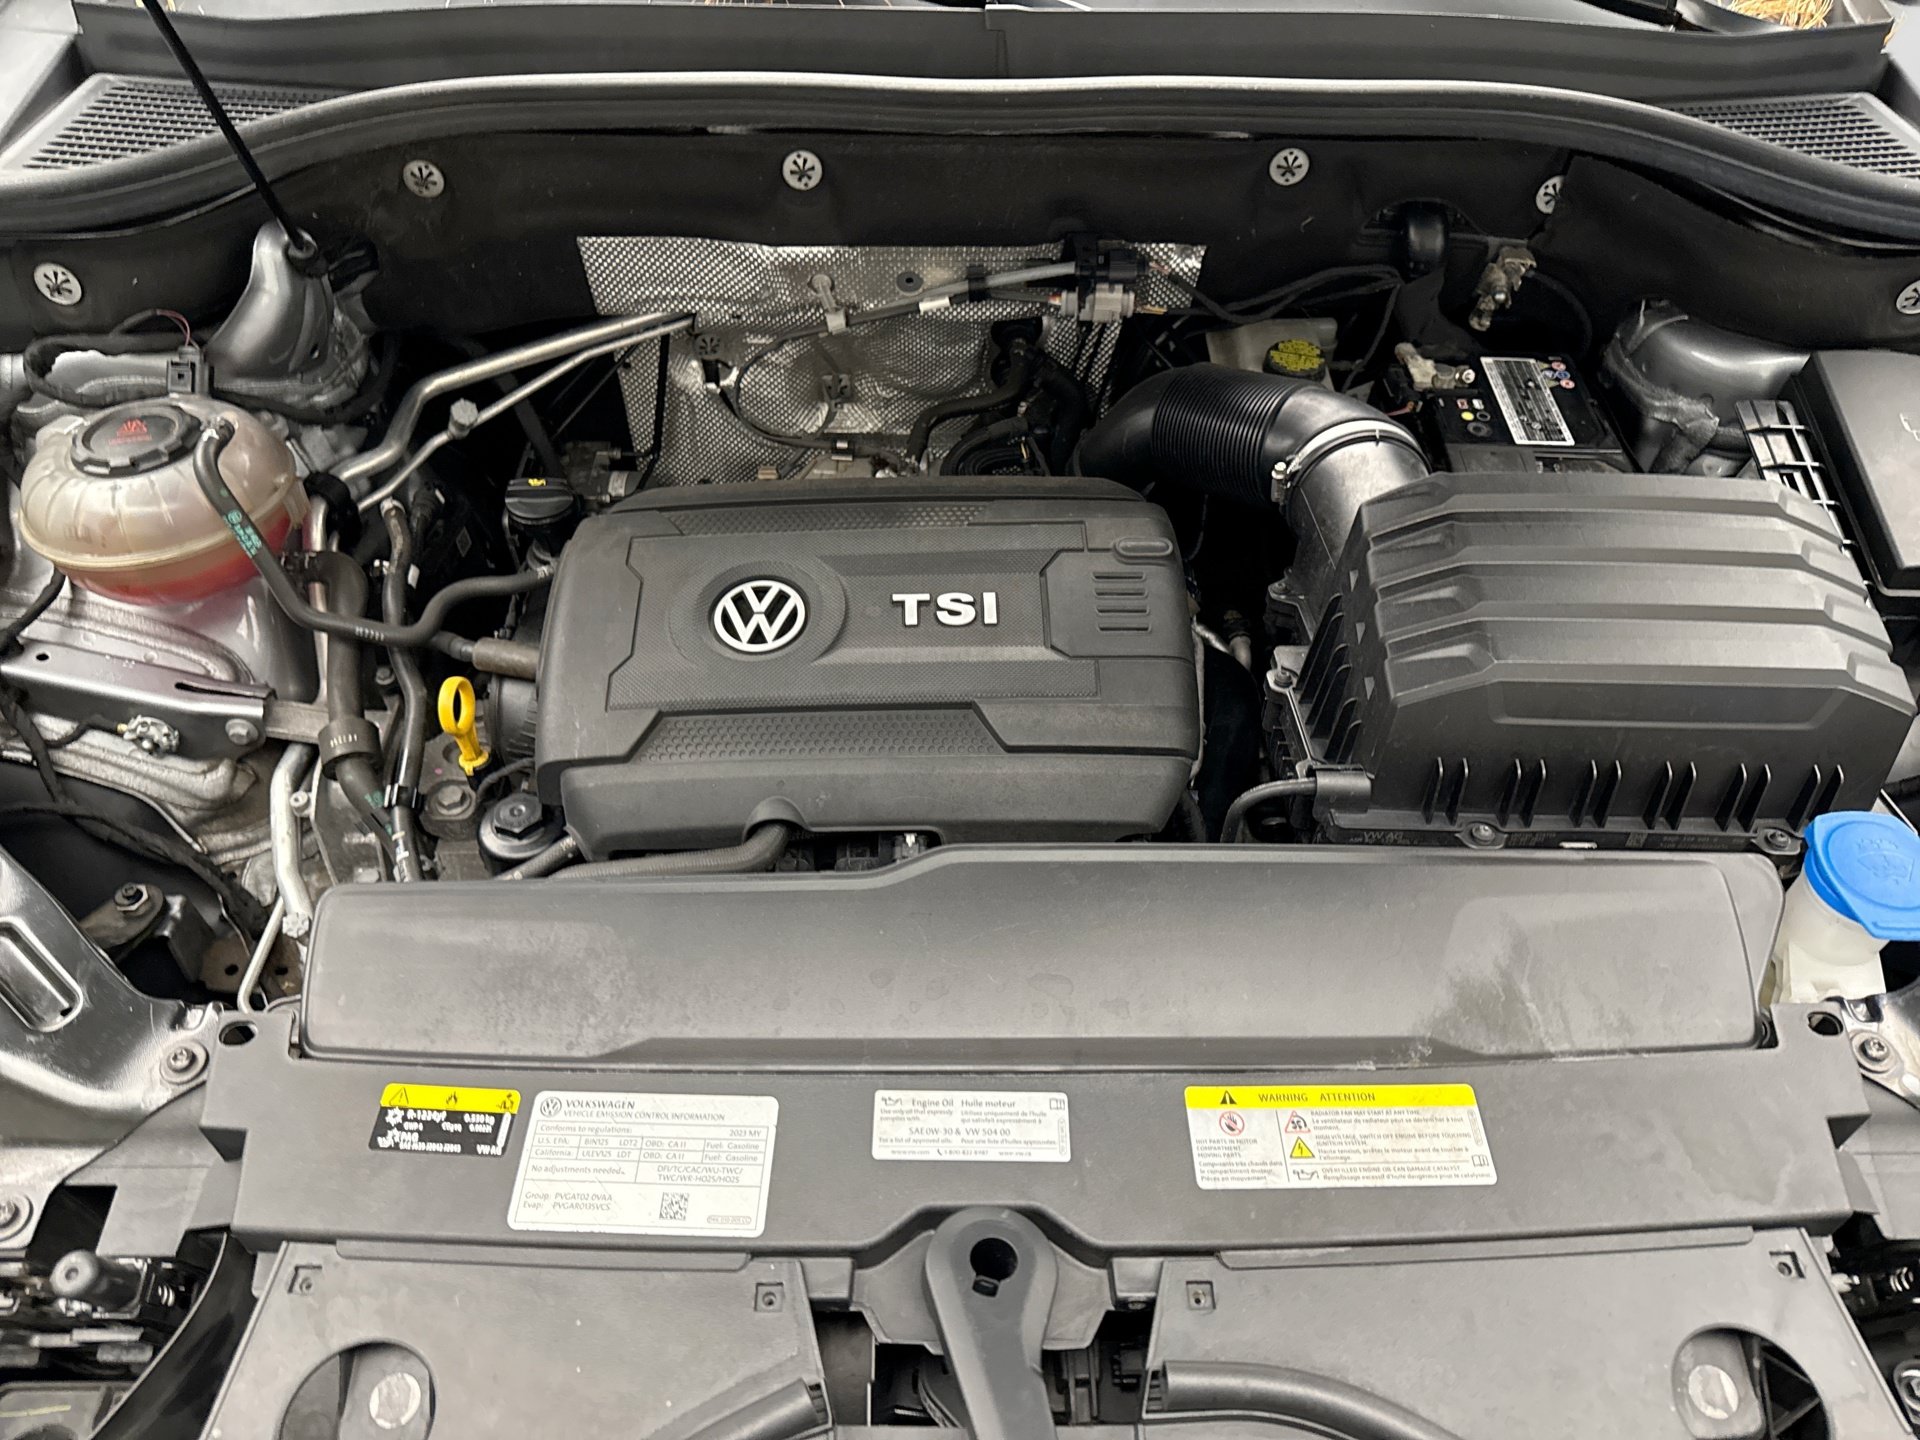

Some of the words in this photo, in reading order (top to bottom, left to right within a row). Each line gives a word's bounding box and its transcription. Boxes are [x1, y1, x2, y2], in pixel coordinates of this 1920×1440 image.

[892, 591, 998, 626] TSI
[1257, 1092, 1308, 1102] WARNING
[1319, 1092, 1376, 1102] ATTENTION
[566, 1099, 635, 1110] VOLKSWAGEN
[912, 1098, 940, 1110] Engine
[941, 1098, 954, 1107] Oil
[961, 1099, 983, 1107] Huile
[985, 1100, 1016, 1108] moteur
[564, 1110, 593, 1118] VEHICLE
[596, 1110, 633, 1119] EMISSION
[635, 1112, 669, 1120] CONTROL
[671, 1112, 725, 1121] INFORMATION
[540, 1124, 576, 1133] Conforms
[587, 1127, 632, 1136] regulations:
[729, 1129, 747, 1137] 2023
[748, 1129, 762, 1137] MY
[908, 1127, 925, 1136] SAE
[954, 1127, 961, 1136] &
[965, 1128, 980, 1136] VW
[981, 1128, 998, 1137] 504
[999, 1128, 1011, 1137] 00
[619, 1139, 638, 1147] LDT2
[668, 1140, 680, 1148] CA
[727, 1142, 760, 1150] Gasoline
[725, 1154, 758, 1162] Gasoline
[531, 1164, 543, 1172] No
[544, 1165, 591, 1175] adjustments
[593, 1167, 626, 1175] needed.
